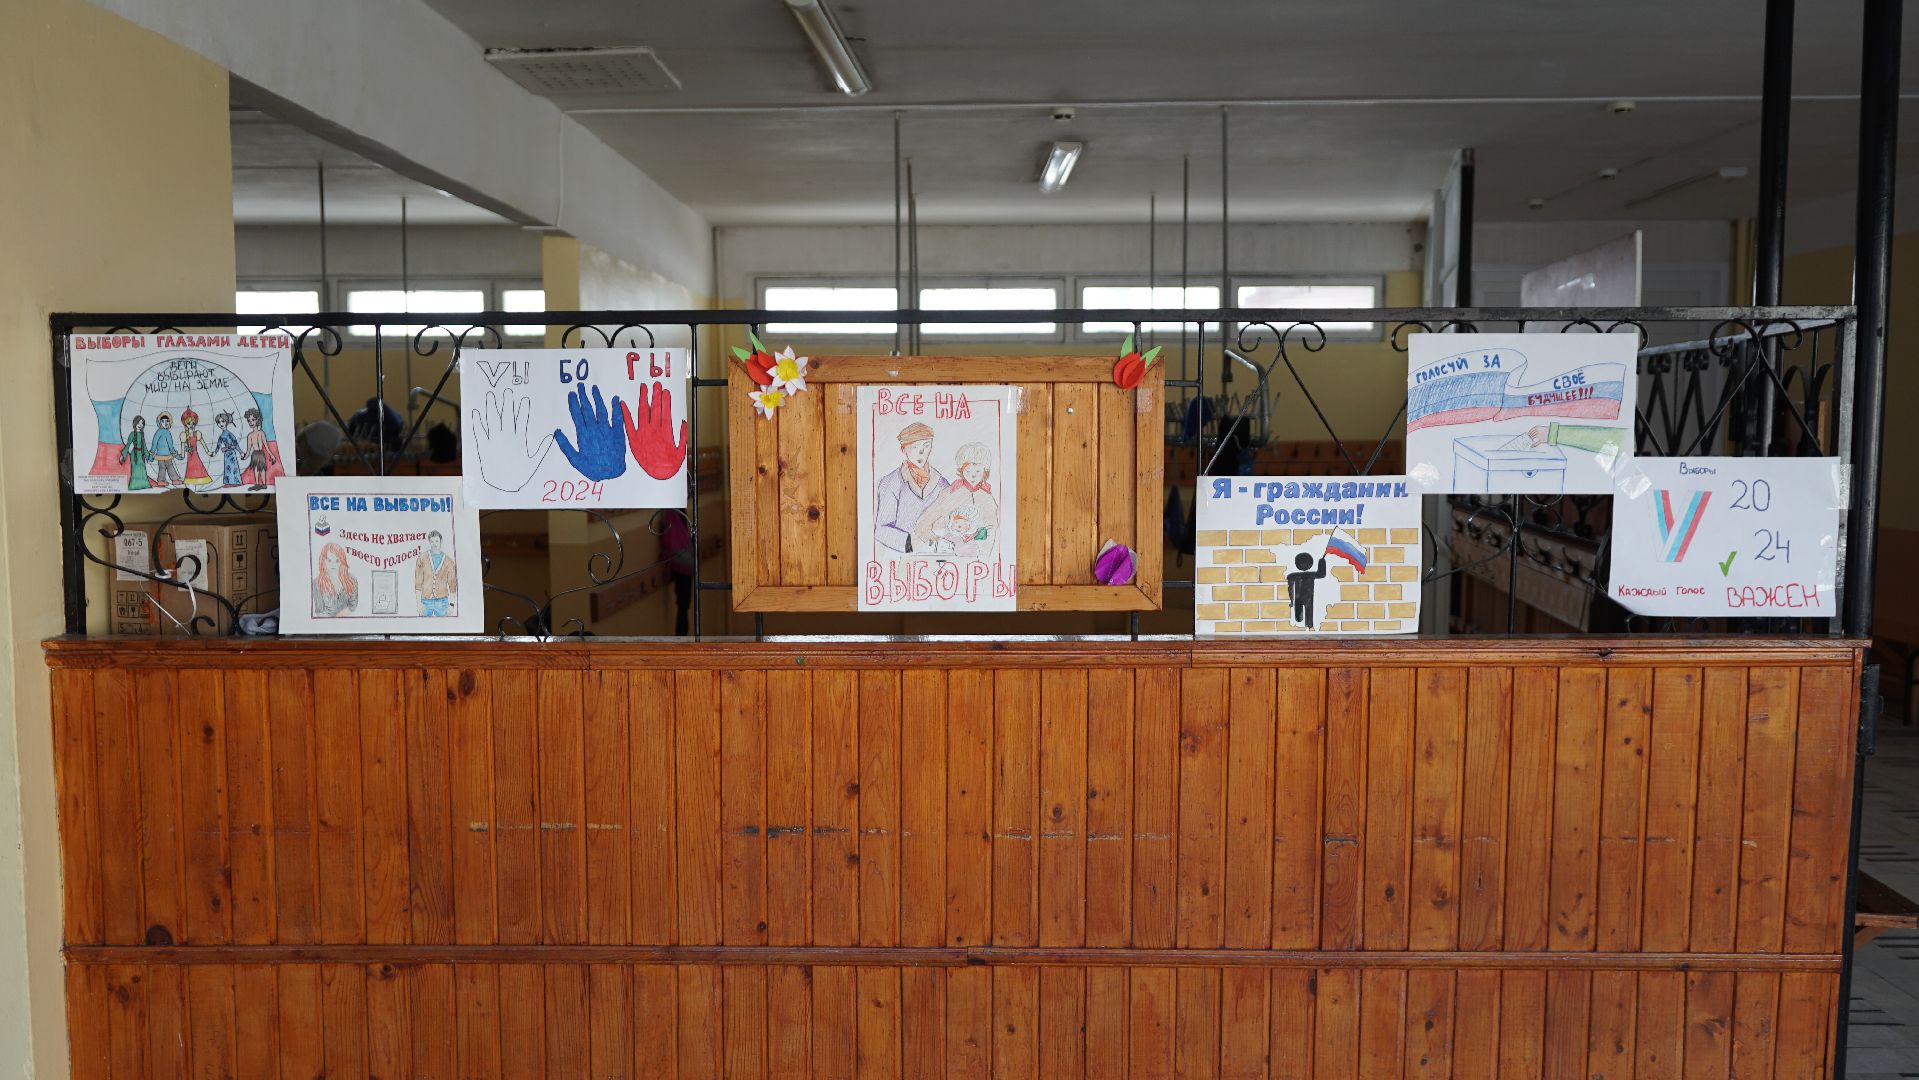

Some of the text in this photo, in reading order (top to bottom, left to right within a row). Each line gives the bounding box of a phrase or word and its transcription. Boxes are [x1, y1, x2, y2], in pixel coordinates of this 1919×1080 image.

[75, 335, 290, 350] ВЫБОРЫ ГЛАЗАМИ ДЕТЕЙ
[157, 368, 215, 382] ВЫБИРАЮТ
[170, 361, 197, 371] ДЕТИ
[559, 358, 590, 384] БО
[626, 352, 671, 380] РЫ
[1415, 354, 1501, 384] ГОЛОСУЙ ЗА
[145, 377, 230, 393] МИР НА ЗЕМЛЕ
[1553, 369, 1586, 390] СВОЁ
[877, 388, 971, 420] ВСЕ НА
[542, 479, 605, 502] 2024
[1212, 478, 1232, 499] Я
[1253, 478, 1408, 502] гражданин
[1729, 478, 1771, 512] 20
[309, 495, 451, 513] ВСЕ НА ВЫБОРЫ!
[1256, 503, 1365, 526] России!
[339, 528, 427, 545] Здесь не хватает
[1754, 528, 1790, 563] 24
[345, 545, 422, 569] твоего голоса!
[865, 560, 1017, 606] ВЫБОРЫ
[1727, 583, 1820, 608] ВАЖЕН
